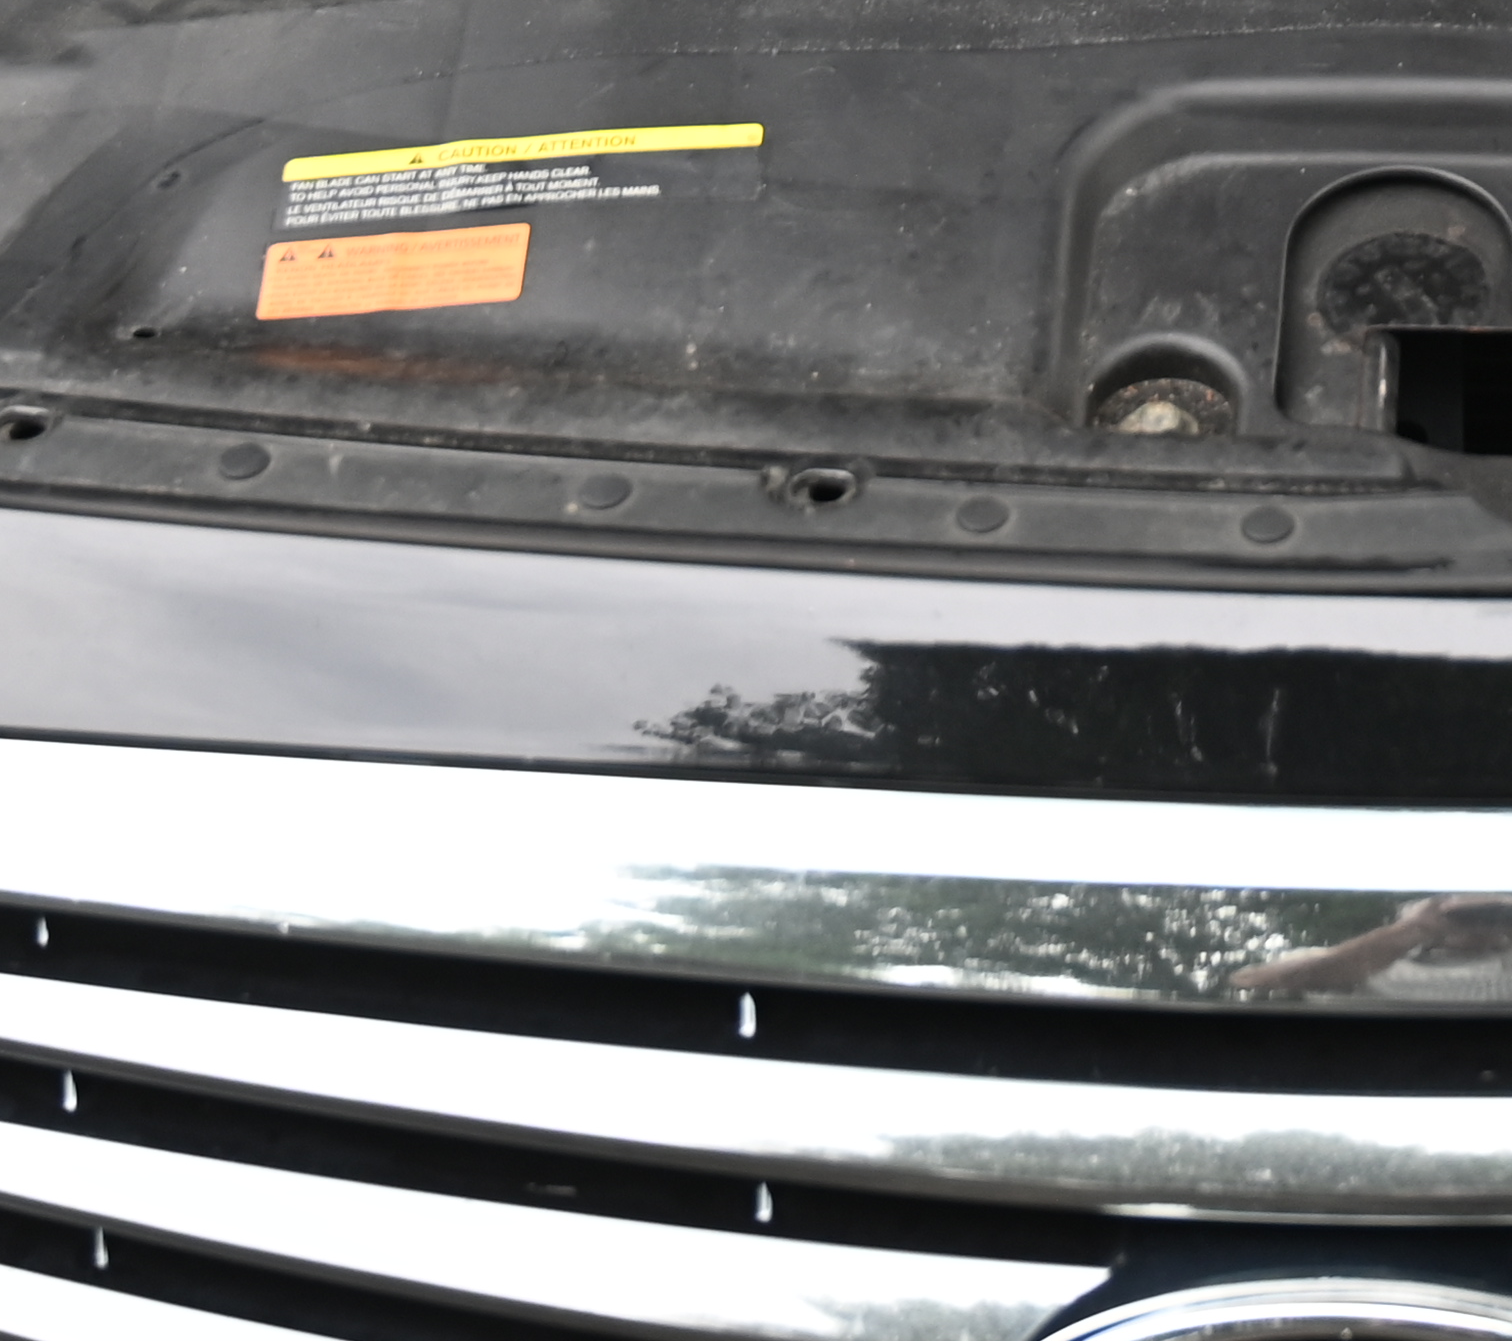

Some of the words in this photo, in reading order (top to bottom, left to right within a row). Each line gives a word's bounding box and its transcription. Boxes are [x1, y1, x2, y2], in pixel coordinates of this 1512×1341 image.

[438, 144, 517, 162] CAUTION
[538, 134, 636, 153] ATTENTION
[292, 181, 314, 191] FAN
[316, 177, 352, 189] BLADE
[355, 174, 380, 185] CAN
[383, 171, 417, 183] START
[419, 170, 433, 179] AT
[436, 166, 459, 177] ANY
[460, 163, 487, 174] TIME.
[292, 192, 306, 202] TO
[309, 189, 338, 200] HELP
[340, 186, 374, 198] AVOID
[376, 181, 436, 195] PERSONAL
[476, 172, 507, 184] KEEP
[509, 169, 549, 181] HANDS
[552, 165, 592, 178] CLEAR.
[286, 214, 319, 226] POUR
[321, 209, 360, 223] ÉVITER
[363, 207, 396, 219] TOUTE
[463, 198, 479, 209] NE
[482, 195, 503, 206] PAS
[506, 192, 522, 203] EN
[525, 186, 597, 201] APPROCHER
[598, 185, 620, 197] LES
[623, 183, 661, 196] MAINS.
[288, 205, 301, 215] LE
[304, 198, 376, 213] VENTILATEUR
[379, 194, 421, 207] RISQUE
[424, 192, 439, 202] DE
[442, 185, 502, 201] DÉMARRER
[505, 181, 514, 194] À
[515, 181, 546, 193] TOUT
[549, 175, 600, 189] MOMENT.
[347, 241, 410, 257] WARNING
[420, 232, 521, 253] AVERTISSEMENT
